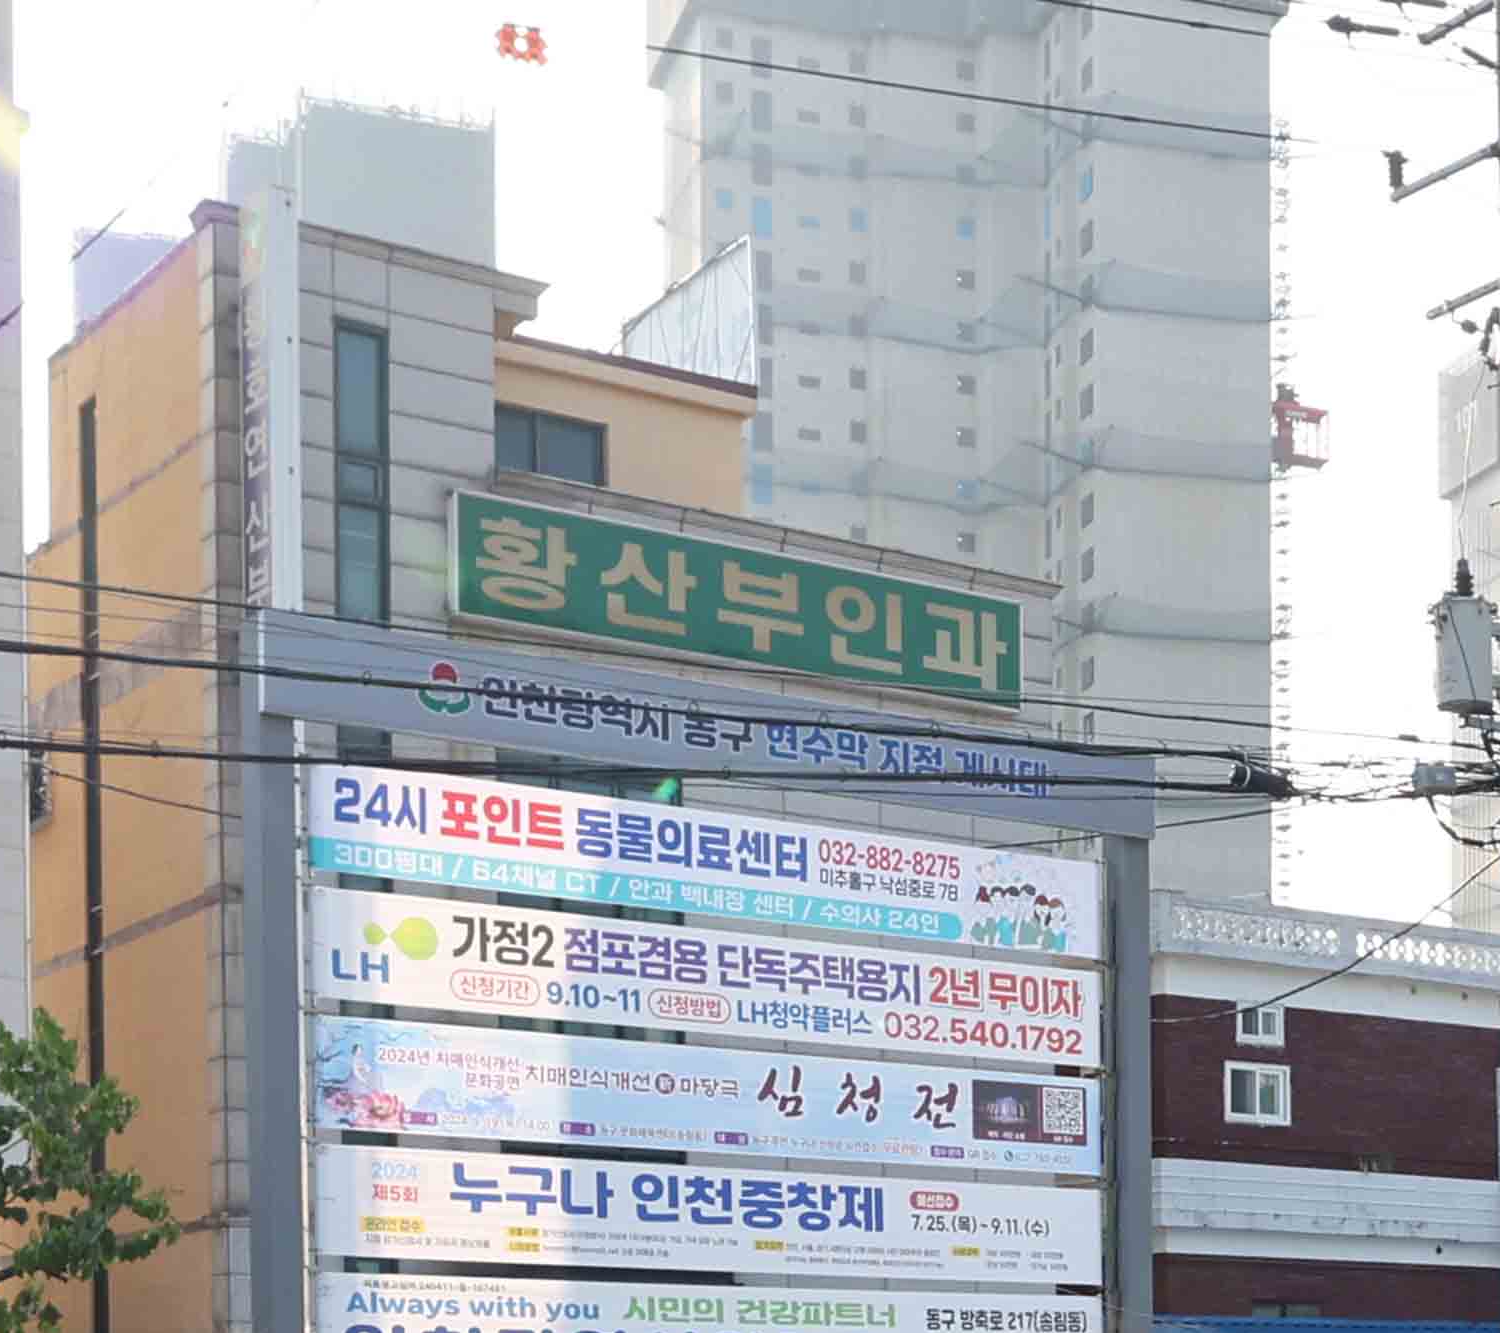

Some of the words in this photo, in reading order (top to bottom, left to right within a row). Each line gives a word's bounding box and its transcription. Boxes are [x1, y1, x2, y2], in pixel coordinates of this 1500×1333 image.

[474, 515, 1008, 692] 황산부인과
[480, 676, 671, 742] 인천광역시
[765, 719, 870, 771] 현수막
[333, 776, 428, 835] 24시
[440, 788, 565, 851] 포인트
[575, 805, 809, 883] 동물의료센터
[818, 838, 961, 881] 032-882-8275
[564, 871, 603, 895] CT
[628, 878, 674, 906] 안과
[680, 884, 747, 912] 백내장
[753, 896, 795, 919] 센터
[819, 904, 884, 928] 수의사
[888, 911, 942, 935] 24인
[818, 868, 877, 893] 미추홀구
[878, 876, 936, 900] 낙섬중로
[939, 883, 960, 902] 78
[331, 948, 390, 984] LH
[451, 913, 556, 969] 가정2
[563, 926, 709, 985] 점포겸용
[717, 941, 922, 1007] 단독주택용지
[928, 965, 982, 1012] 2년
[987, 971, 1084, 1020] 무이자
[458, 975, 531, 1001] 신청기간
[546, 982, 642, 1013] 9.10~11
[655, 994, 723, 1020] 신청방법
[736, 999, 874, 1037] LH청약플러스
[884, 1011, 1084, 1055] 032.540.1792
[378, 1048, 430, 1067] 2024년
[435, 1051, 521, 1073] 치매인식개선
[524, 1065, 651, 1093] 치매인식개선
[680, 1076, 740, 1100] 마당극
[371, 1162, 419, 1179] 2024
[371, 1183, 419, 1203] 제5회
[449, 1162, 615, 1220] 누구나
[631, 1172, 885, 1232] 인천중창제
[345, 1291, 461, 1318] Always
[469, 1293, 537, 1319] with
[546, 1300, 601, 1324] you
[623, 1295, 725, 1324] 시민의
[736, 1297, 898, 1329] 건강파트너
[925, 1307, 957, 1332] 동구
[959, 1309, 1006, 1332] 방축로
[1008, 1310, 1089, 1333] 217(송림동)
